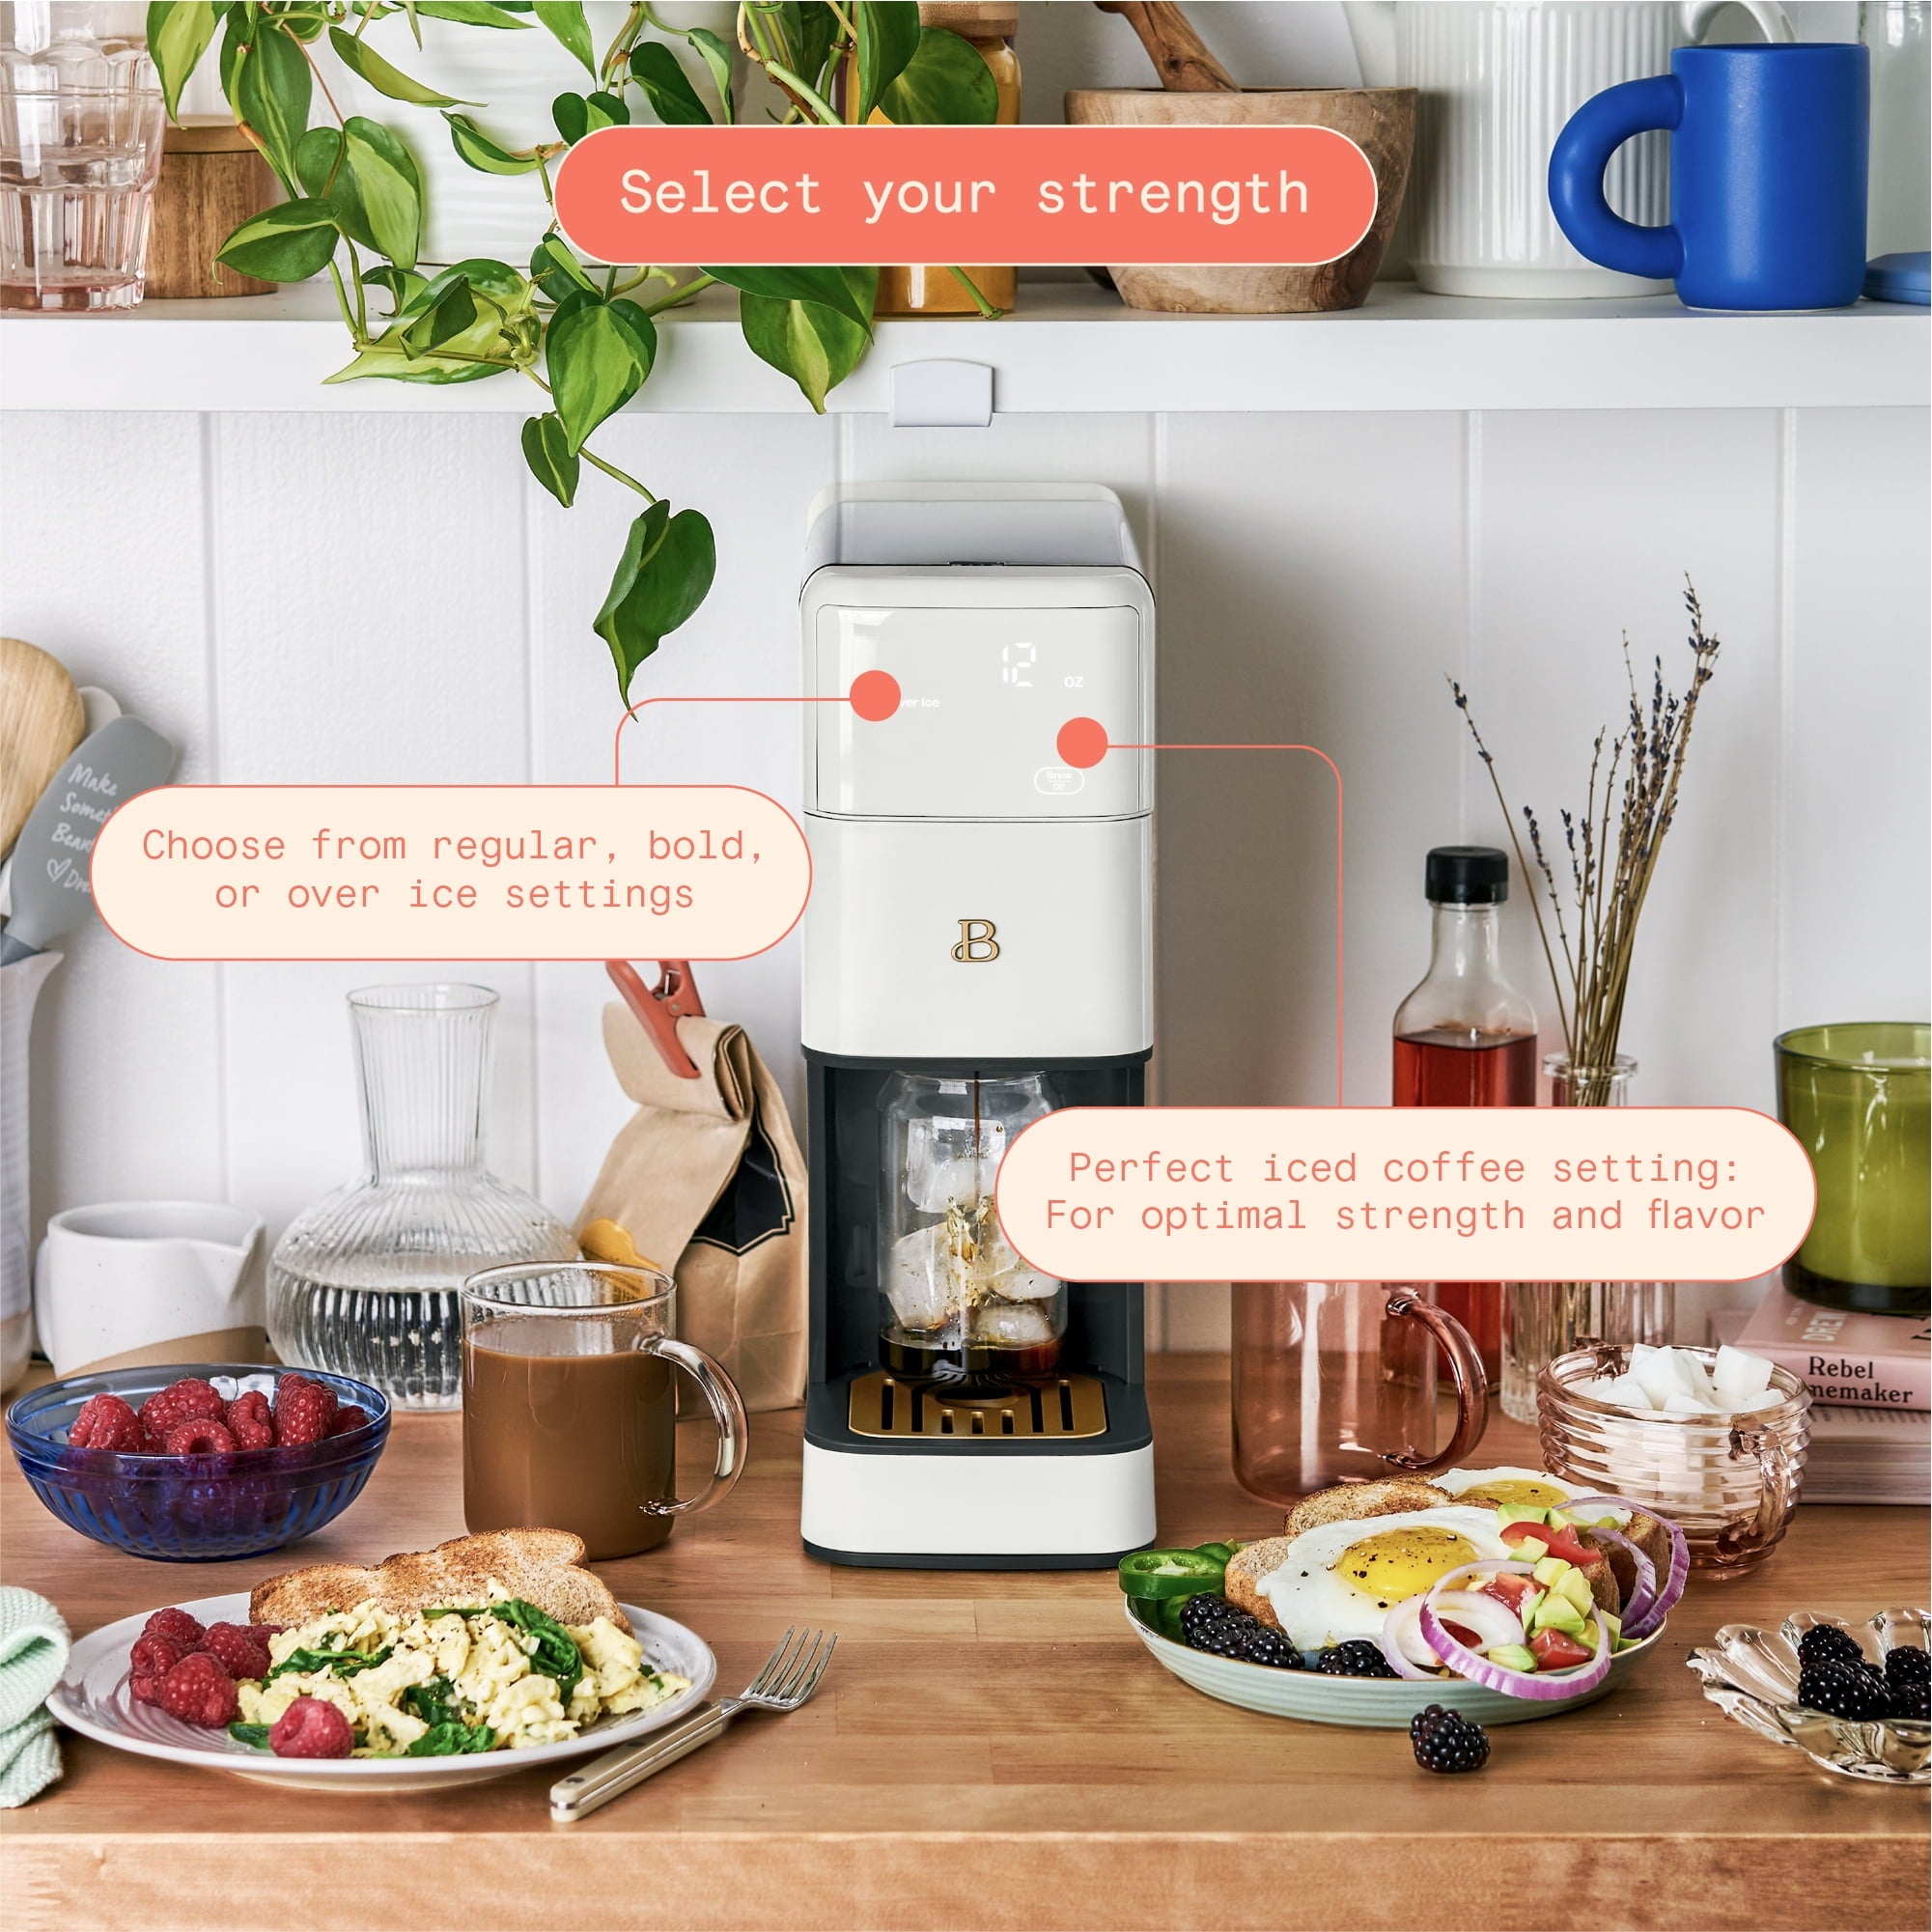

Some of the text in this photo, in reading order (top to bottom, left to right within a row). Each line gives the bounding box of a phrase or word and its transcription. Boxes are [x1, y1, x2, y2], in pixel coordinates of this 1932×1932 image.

[1002, 642, 1036, 686] 12
[900, 696, 939, 708] ver Ice
[69, 763, 118, 797] Make
[1046, 771, 1073, 780] Brew
[951, 919, 999, 963] B
[1808, 1356, 1874, 1379] Rebel
[1808, 1383, 1913, 1403] memaker
